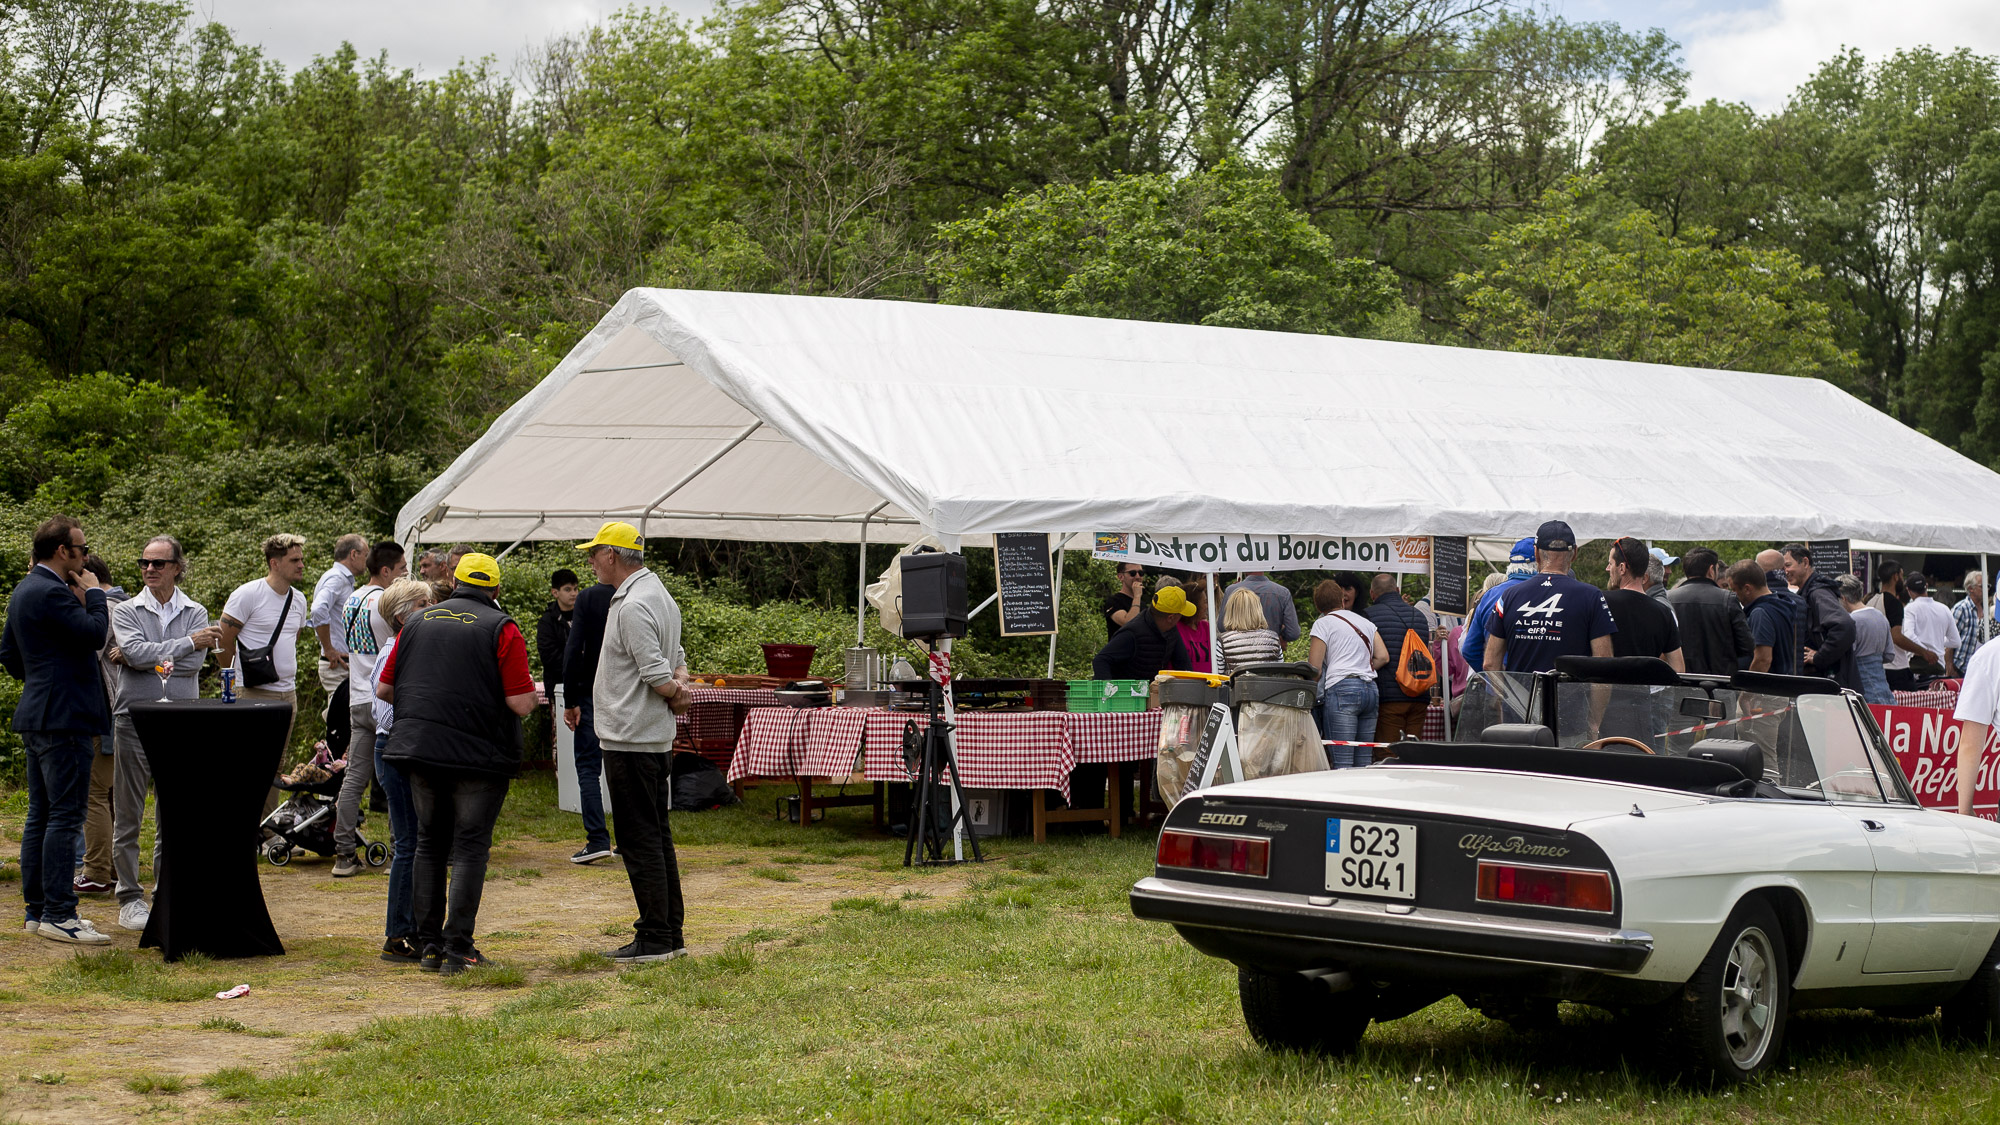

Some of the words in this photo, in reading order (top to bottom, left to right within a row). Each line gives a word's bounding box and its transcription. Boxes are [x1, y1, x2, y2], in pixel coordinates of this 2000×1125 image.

[1135, 533, 1227, 563] Bistrot
[1236, 533, 1269, 561] du
[1278, 534, 1390, 562] Bouchon
[1198, 812, 1249, 827] 2000
[1330, 839, 1336, 848] F
[1350, 825, 1400, 858] 623
[1458, 833, 1501, 858] Alfa
[1501, 836, 1570, 857] Romeo
[1341, 857, 1404, 892] SQ41
